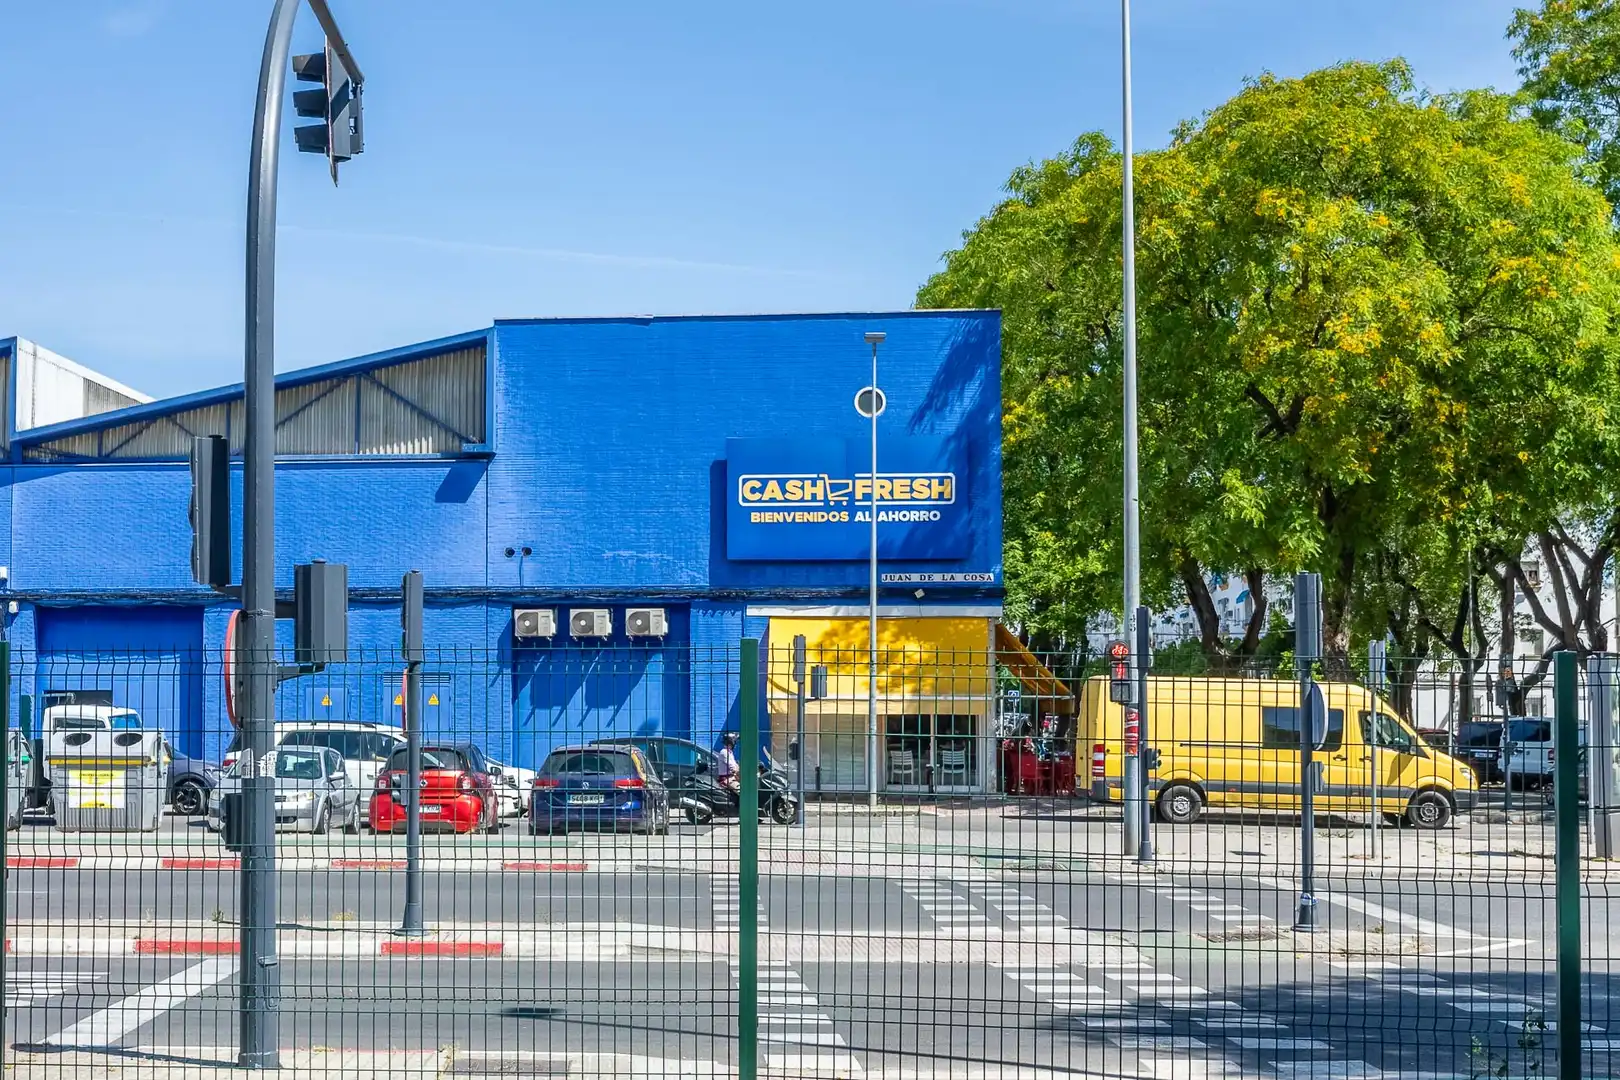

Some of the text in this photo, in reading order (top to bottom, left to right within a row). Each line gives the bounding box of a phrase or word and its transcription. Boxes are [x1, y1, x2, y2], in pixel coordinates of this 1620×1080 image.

[742, 478, 952, 501] CASH FRESH
[750, 510, 941, 523] BIENVENIDOS AL AHORRO
[882, 573, 993, 582] JUAN DE LA COSA
